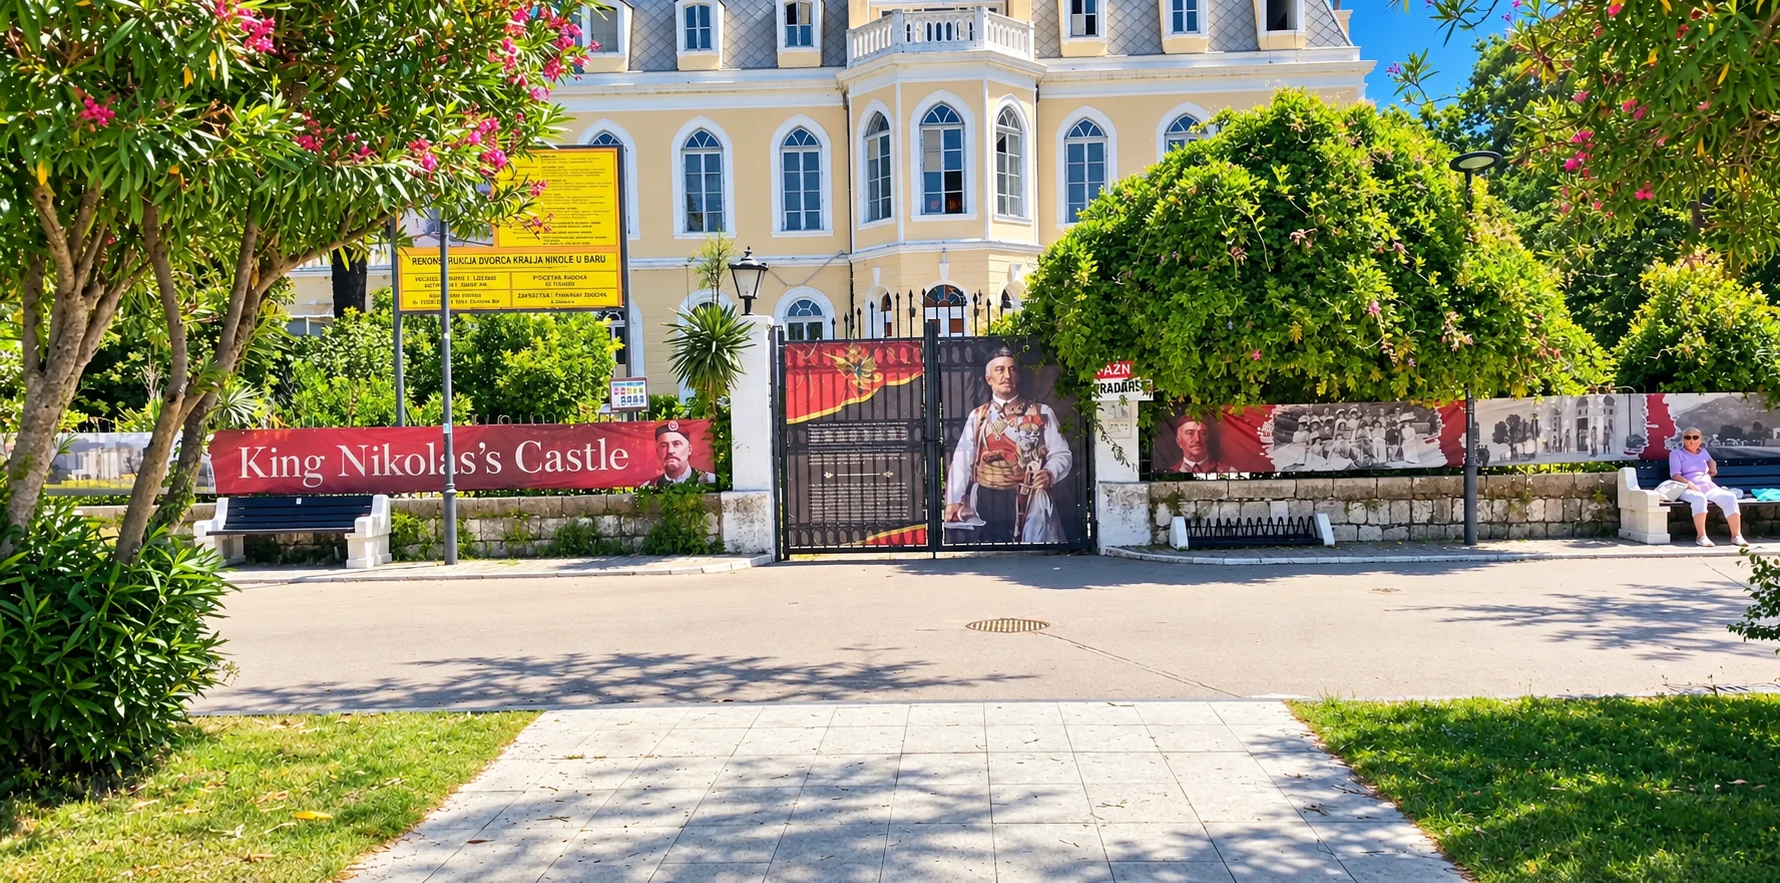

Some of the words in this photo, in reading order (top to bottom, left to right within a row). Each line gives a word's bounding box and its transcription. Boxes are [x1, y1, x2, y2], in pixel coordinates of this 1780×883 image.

[479, 256, 511, 265] DVORCA
[513, 256, 543, 264] KRALJA
[545, 255, 574, 264] NIKOLE
[576, 255, 582, 263] U
[584, 254, 606, 263] BARU
[238, 445, 325, 488] King
[337, 439, 502, 477] Nikolas’s
[514, 436, 630, 474] Castle
